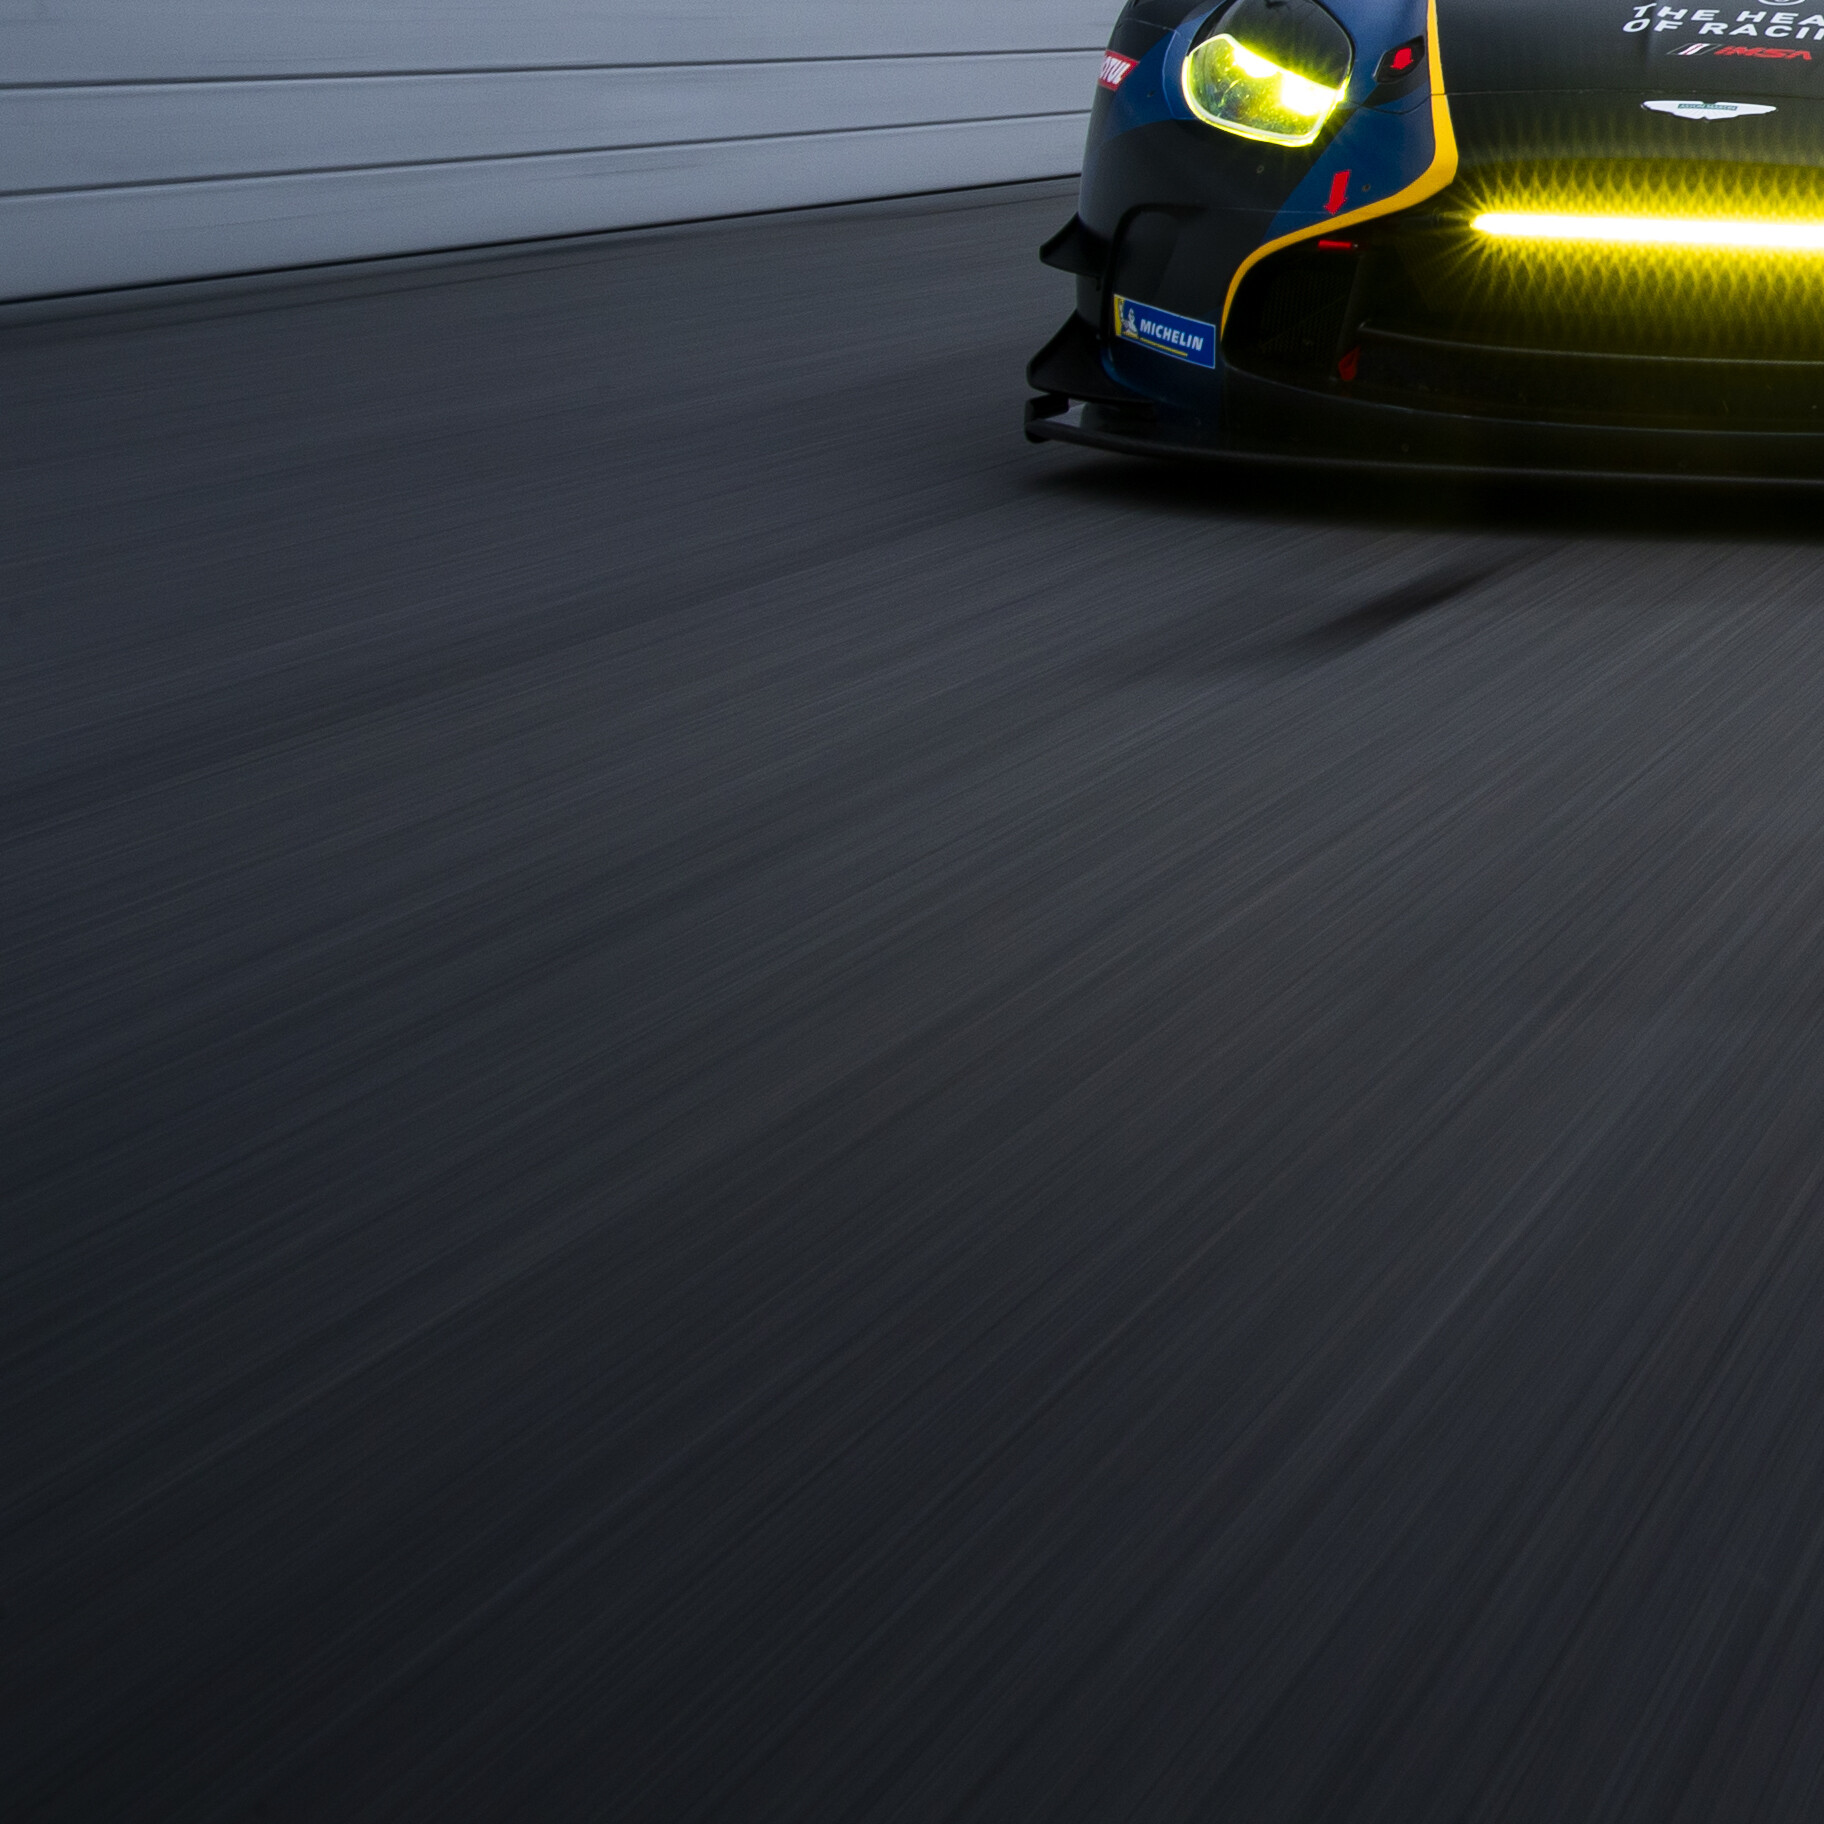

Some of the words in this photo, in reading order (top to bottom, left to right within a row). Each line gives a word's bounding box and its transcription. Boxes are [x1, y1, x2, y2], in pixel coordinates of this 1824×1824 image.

[1633, 3, 1720, 21] THE
[1622, 18, 1683, 33] OF
[1100, 56, 1131, 85] OTUL
[1140, 318, 1204, 351] MICHELIN
